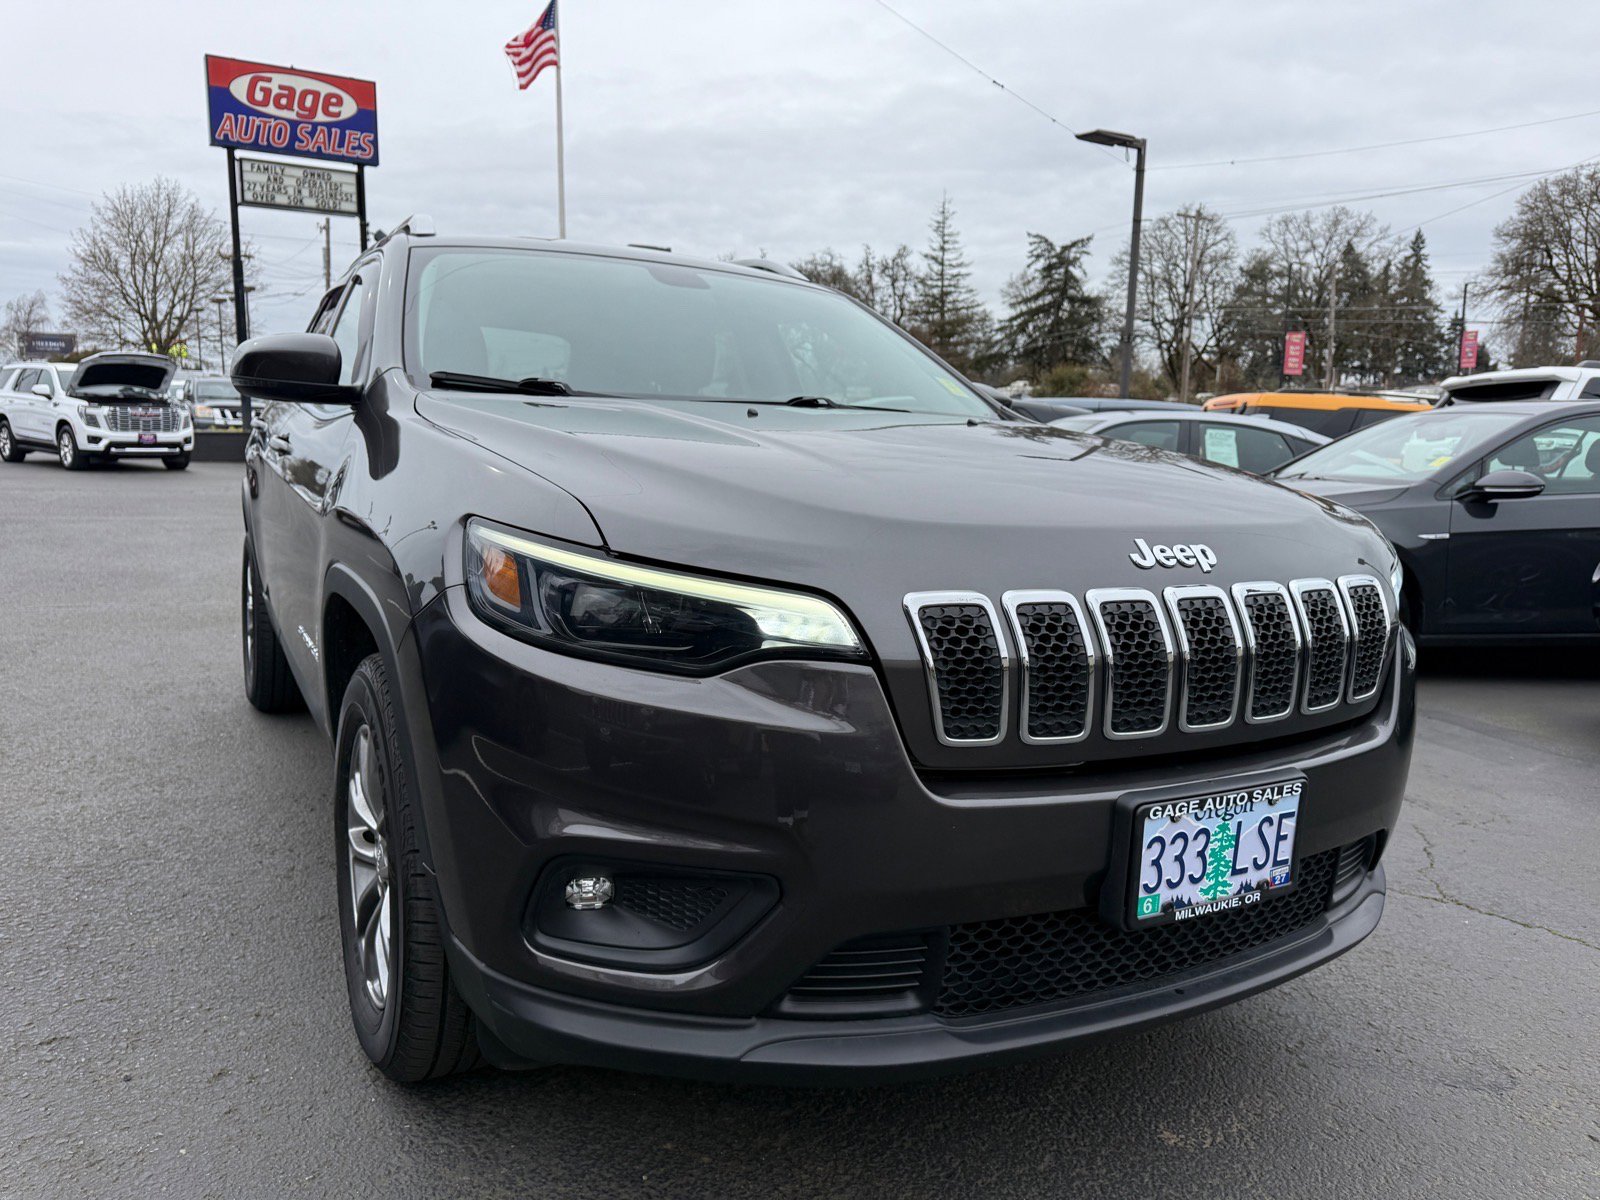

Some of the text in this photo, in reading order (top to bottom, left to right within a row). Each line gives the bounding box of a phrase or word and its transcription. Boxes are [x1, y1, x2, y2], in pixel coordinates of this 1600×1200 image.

[246, 74, 344, 121] Gage
[215, 112, 374, 159] AUTO SALES
[250, 162, 332, 181] FAMILY OWNED
[267, 175, 343, 191] AND OPERATED!
[247, 182, 353, 202] 27 YEARS IN BUSINESS!
[252, 192, 275, 203] OVER
[1128, 538, 1217, 574] Jeep
[1150, 782, 1302, 820] GAGE AUTO SALES
[1142, 811, 1296, 894] 333 LSE
[1274, 873, 1287, 885] 27
[1143, 898, 1152, 913] 6
[1175, 897, 1242, 921] MILWAUKIE,
[1245, 892, 1261, 905] OR
